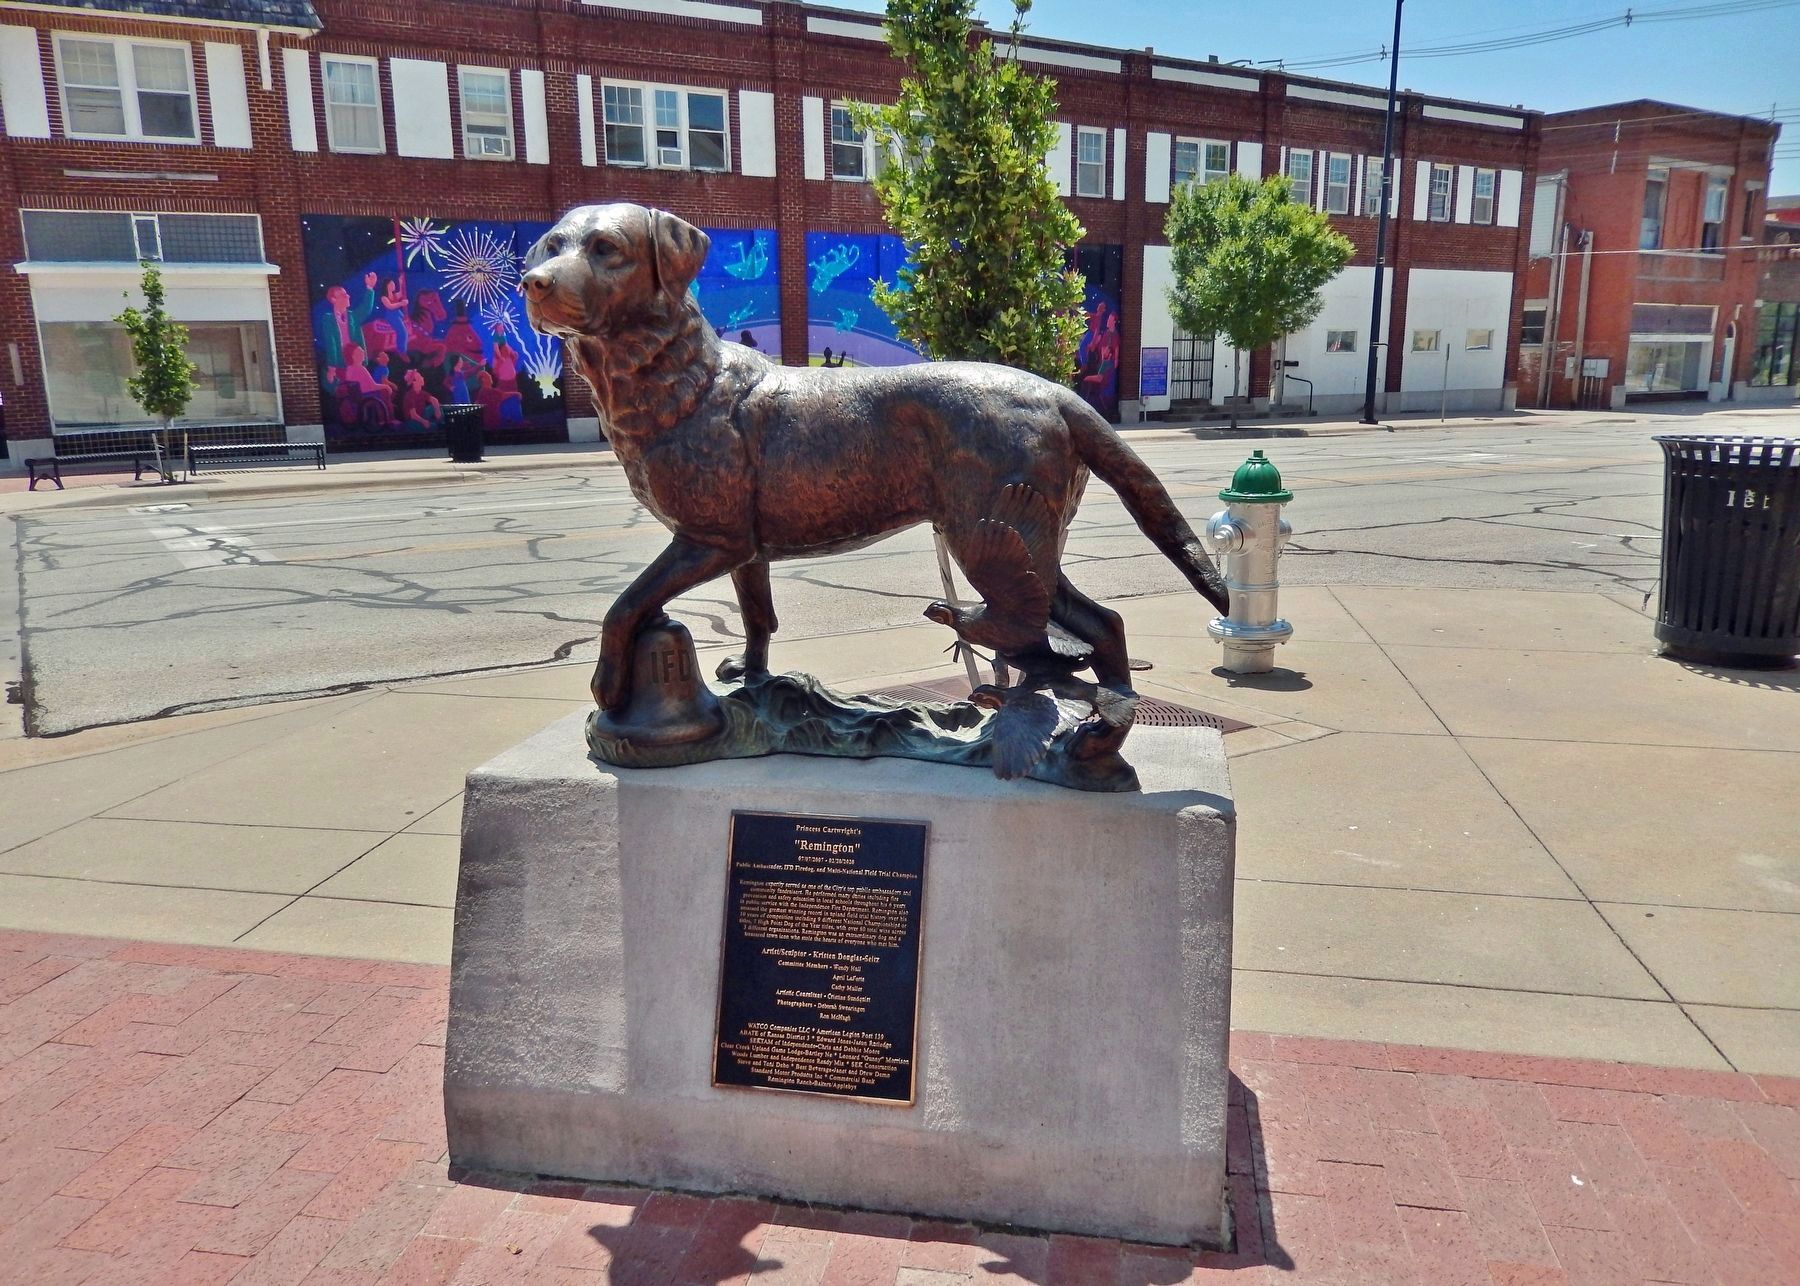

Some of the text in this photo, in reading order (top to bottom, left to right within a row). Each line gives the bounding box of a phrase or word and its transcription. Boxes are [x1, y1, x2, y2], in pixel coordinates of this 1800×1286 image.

[822, 826, 861, 836] Cartwright's
[794, 839, 860, 855] "Remington"
[892, 871, 917, 879] Champion
[761, 946, 806, 958] Artist/Sculptor
[812, 950, 836, 959] Kristen
[776, 999, 813, 1008] Photographers
[769, 1024, 797, 1033] Companies
[842, 1030, 860, 1038] Legion
[780, 1054, 814, 1064] Independence
[828, 1074, 860, 1082] Commercial
